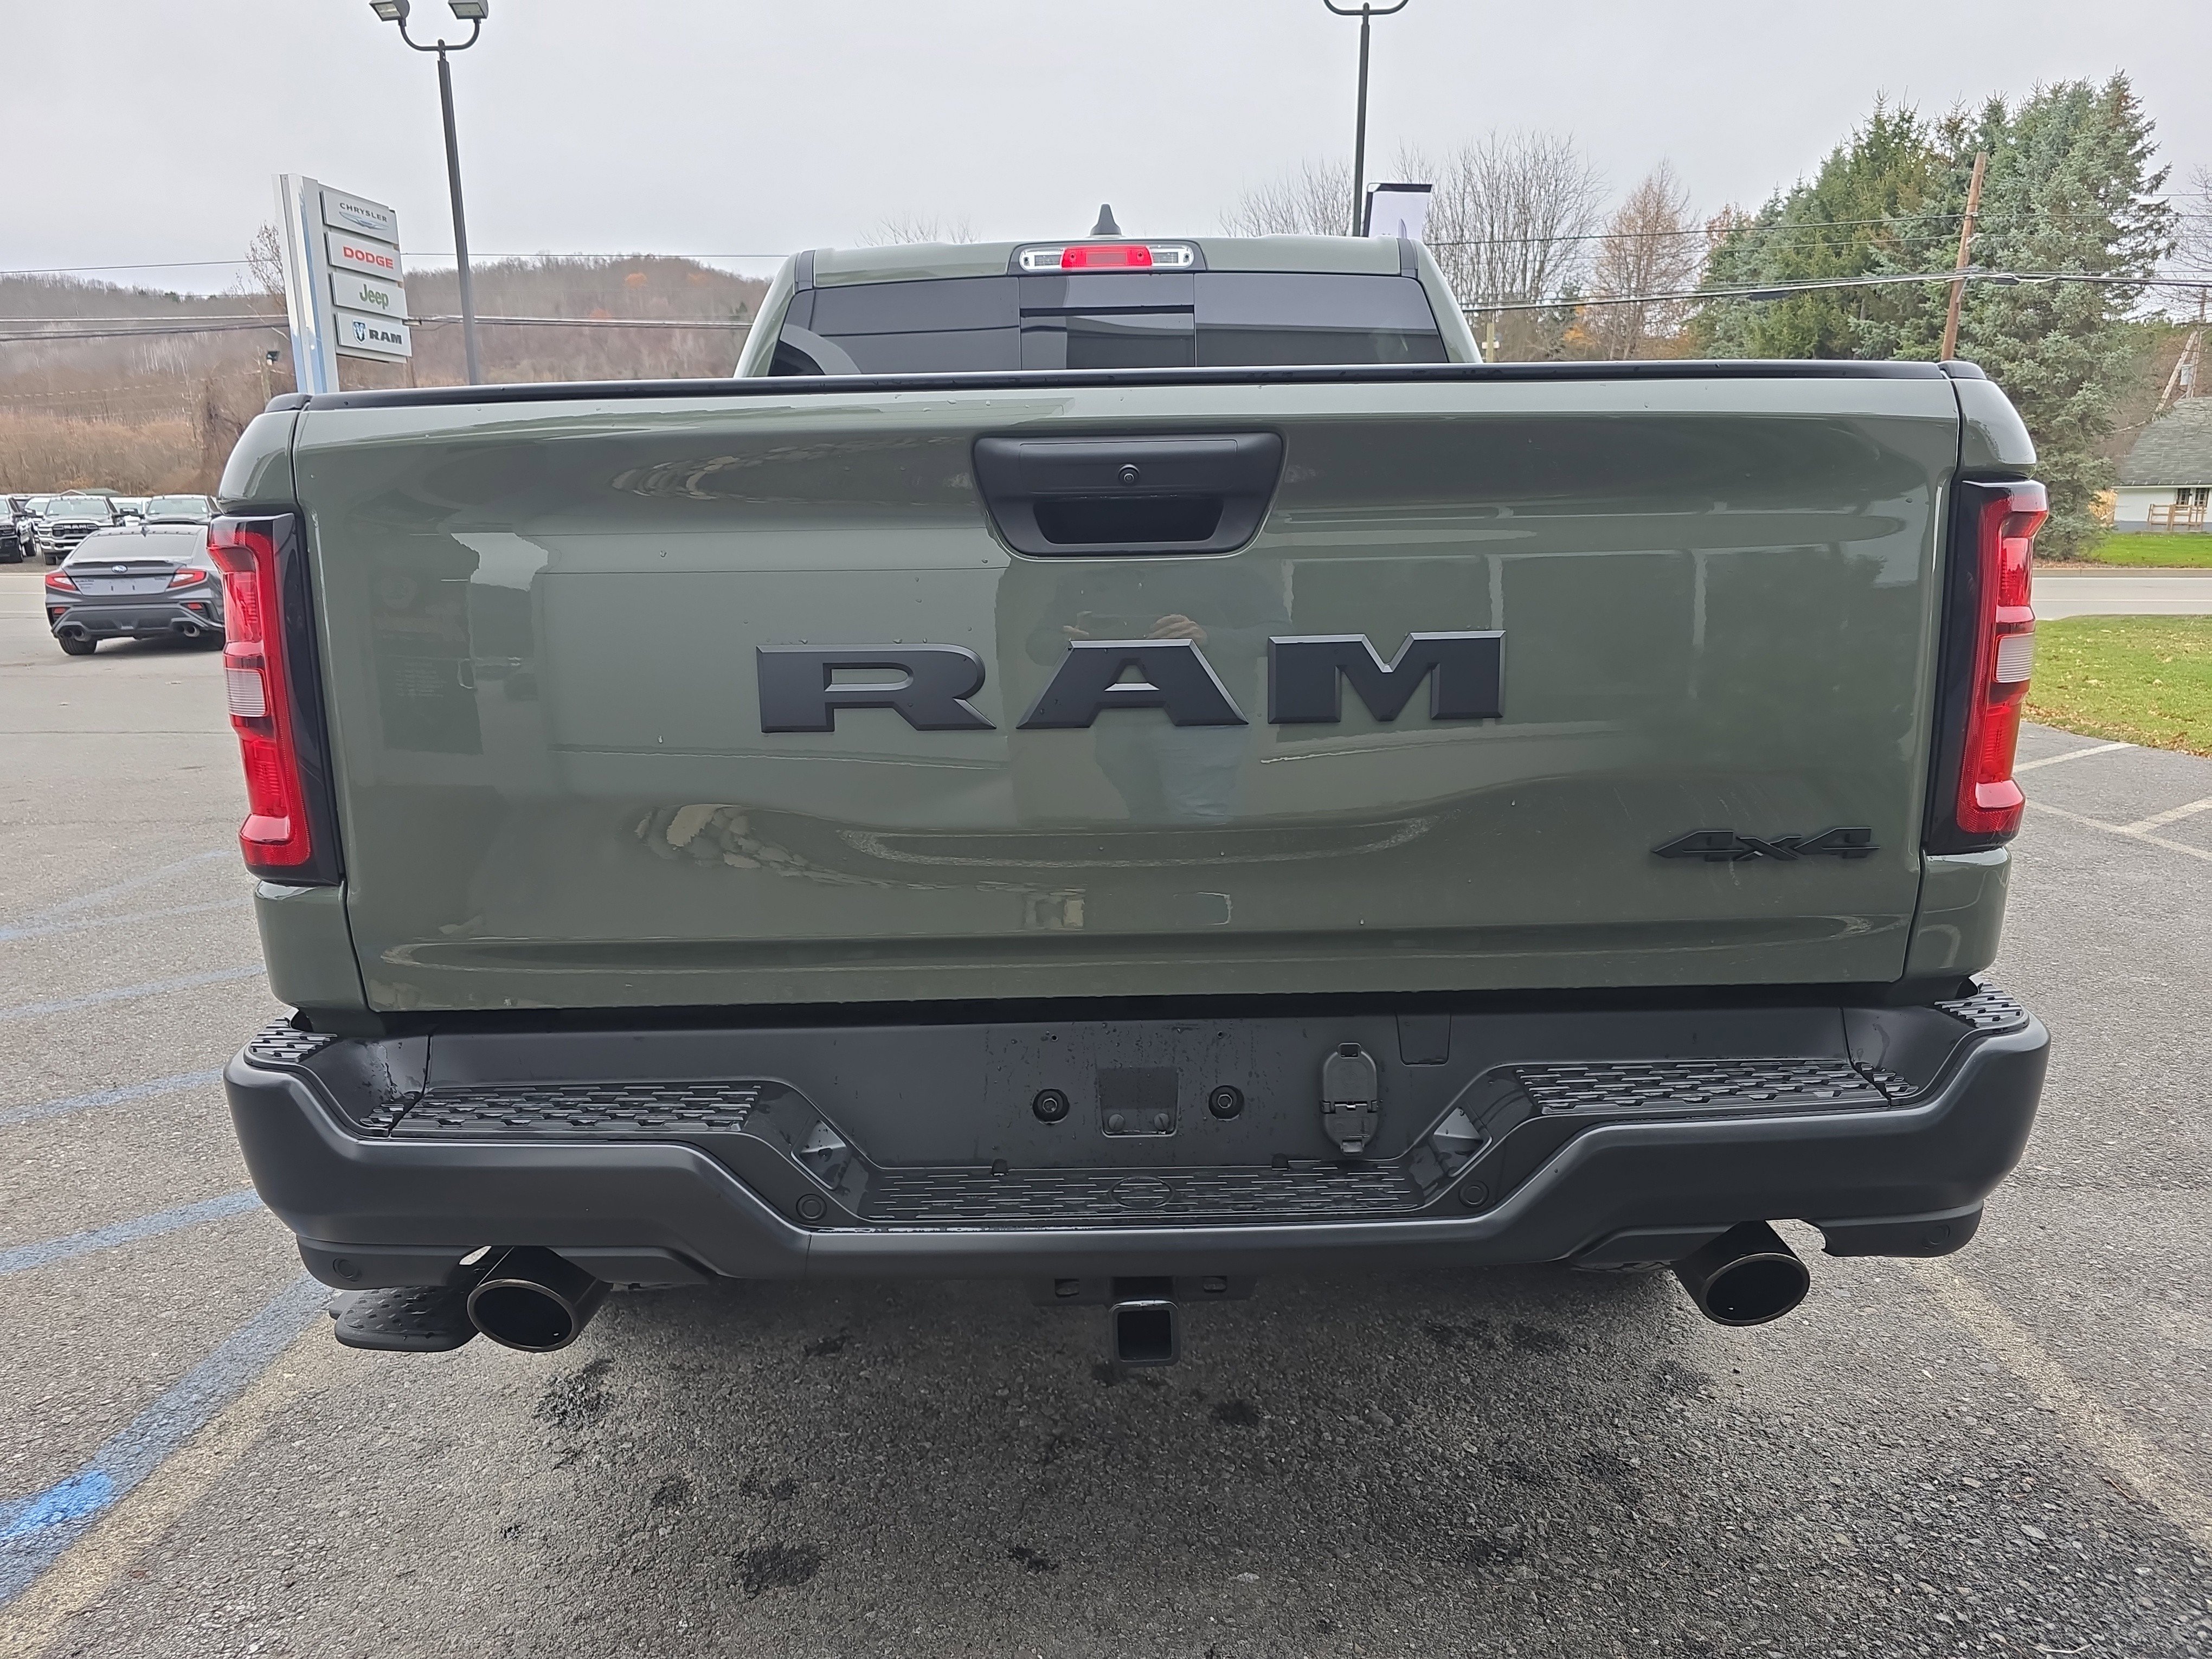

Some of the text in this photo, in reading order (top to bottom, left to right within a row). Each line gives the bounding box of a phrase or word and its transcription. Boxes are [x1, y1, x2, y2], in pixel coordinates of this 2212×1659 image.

[339, 203, 387, 222] CHRYSLER
[343, 246, 394, 269] DODGE
[359, 284, 389, 310] Jeep
[369, 329, 402, 344] RAM
[756, 630, 1506, 732] RAM
[1650, 827, 1881, 862] 4x4
